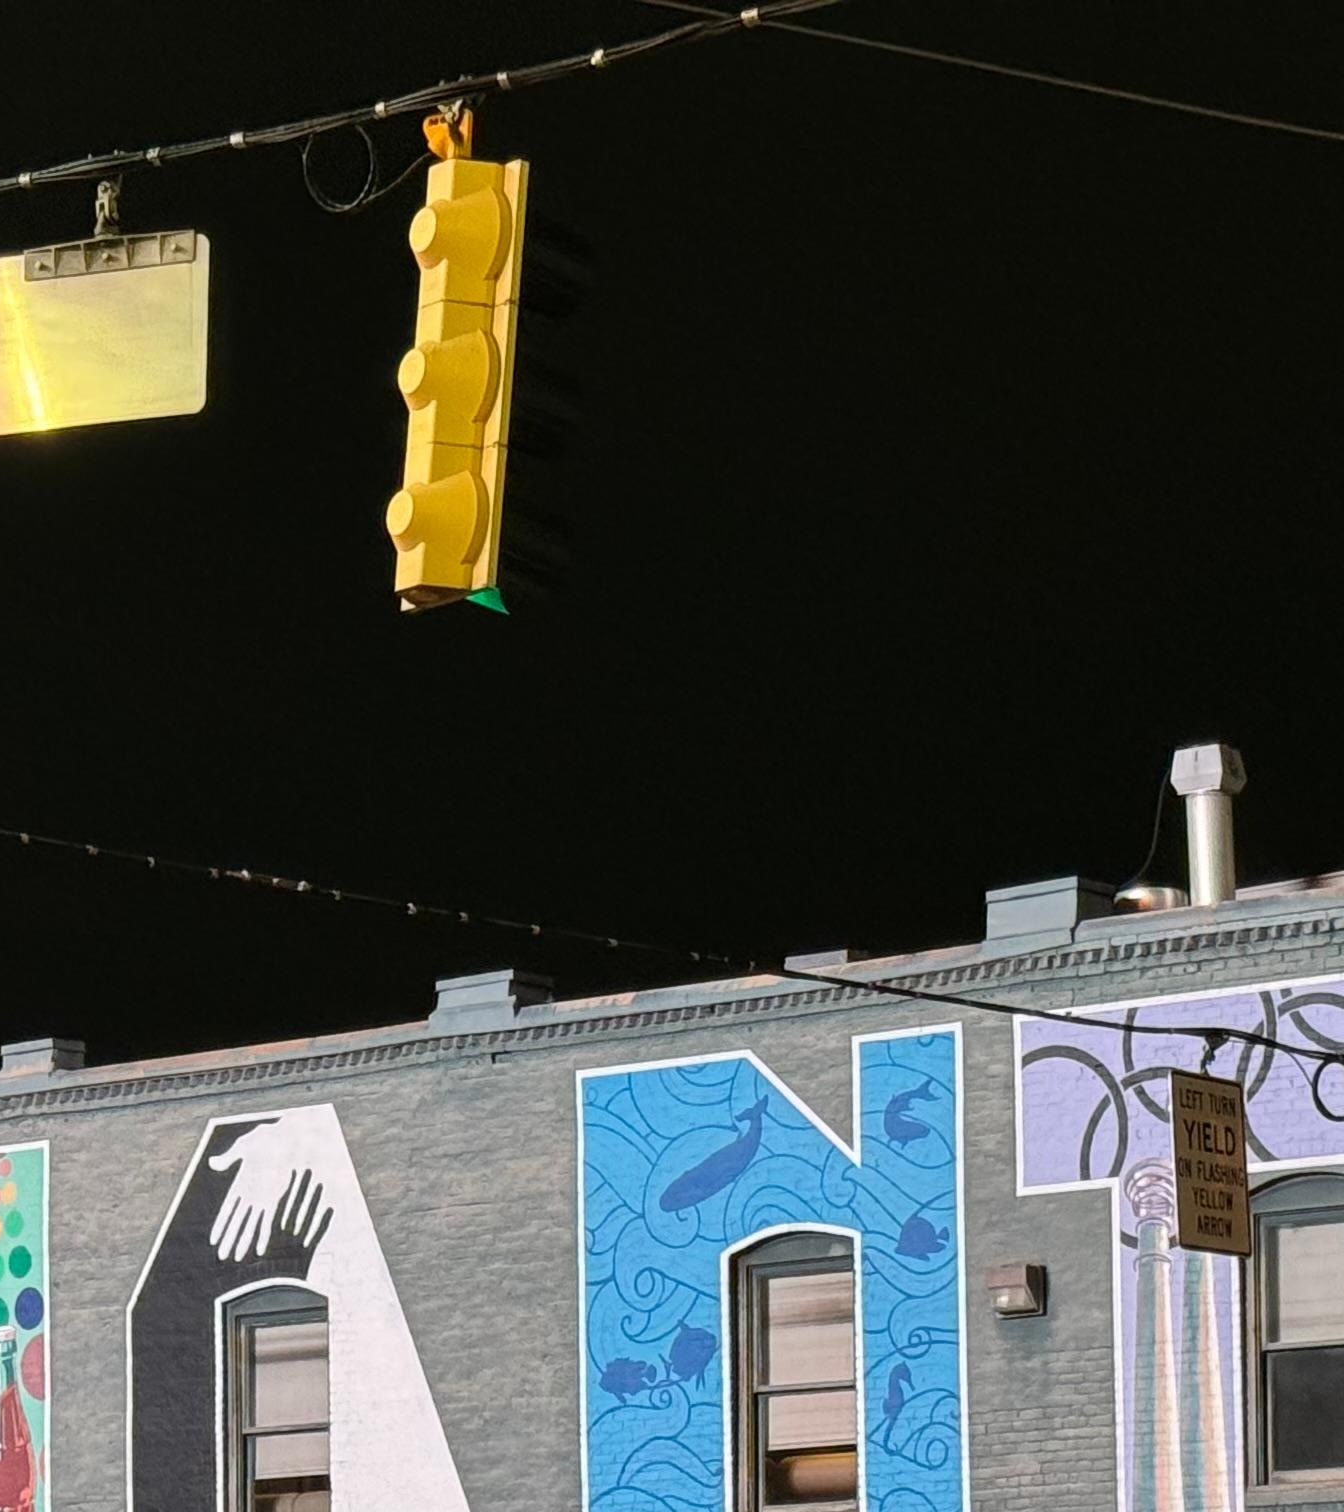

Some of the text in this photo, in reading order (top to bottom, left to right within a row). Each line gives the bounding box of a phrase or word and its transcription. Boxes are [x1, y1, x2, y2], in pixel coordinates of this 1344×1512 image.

[1179, 1087, 1236, 1118] LEFT TURN
[1183, 1118, 1237, 1157] YIELD
[1178, 1156, 1245, 1187] ON FLASHING
[1193, 1186, 1234, 1212] YELLOW
[1196, 1214, 1233, 1239] ARROW
